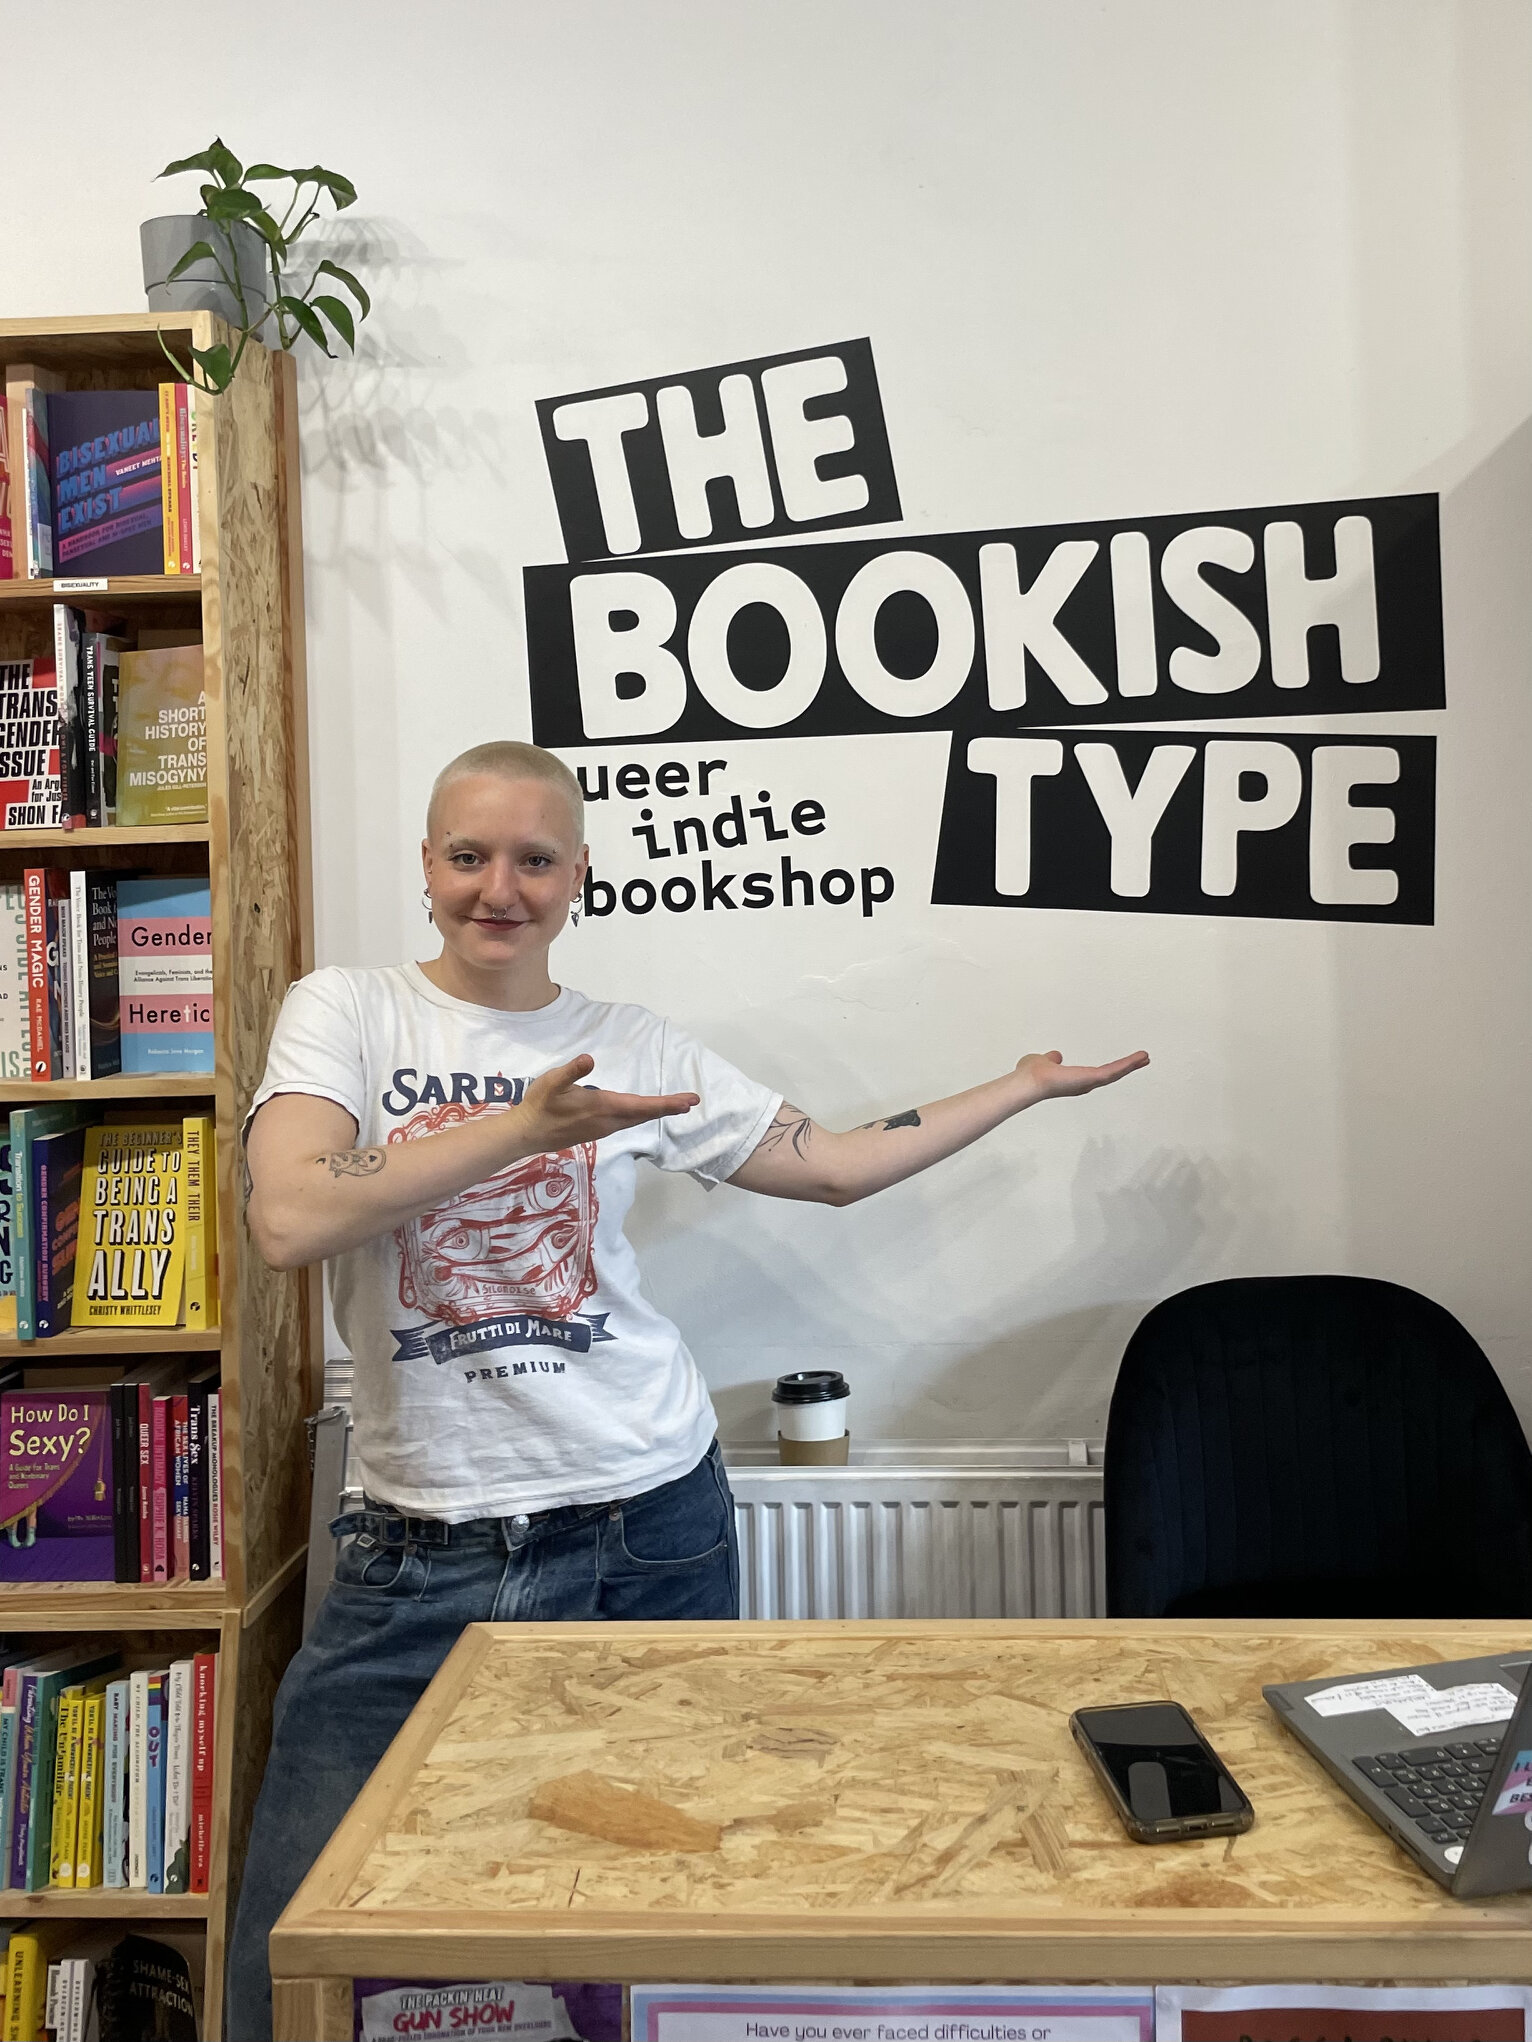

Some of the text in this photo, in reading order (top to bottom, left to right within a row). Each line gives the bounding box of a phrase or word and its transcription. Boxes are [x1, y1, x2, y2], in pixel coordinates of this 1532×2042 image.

[57, 417, 161, 477] BISEXUAL
[179, 407, 188, 459] Bisexuality:
[116, 462, 141, 476] VANEET
[552, 355, 869, 556] THE
[57, 464, 107, 506] MEN
[58, 486, 123, 535] EXIST
[61, 581, 99, 589] BISEXUALITY
[570, 515, 1381, 740] BOOKISH
[86, 645, 94, 669] TRANS
[0, 664, 31, 691] THE
[0, 690, 57, 719] TRANS
[87, 691, 96, 727] SURVIVAL
[198, 691, 205, 704] A
[158, 706, 206, 723] SHORT
[88, 729, 96, 752] GUIDE
[145, 722, 207, 740] HISTORY
[188, 737, 207, 751] OF
[0, 750, 46, 777] SSUE
[158, 752, 207, 769] TRANS
[32, 779, 42, 790] An
[129, 767, 207, 787] MISOGYNY
[577, 759, 728, 802] ueer
[31, 791, 43, 802] for
[8, 805, 45, 826] SHON
[631, 790, 827, 860] indie
[967, 740, 1400, 905] TYPE
[92, 886, 106, 900] The
[584, 856, 895, 918] bookshop
[92, 902, 112, 916] Book
[93, 919, 107, 930] and
[28, 875, 44, 988] GENDER MAGIC
[93, 933, 116, 948] People
[131, 924, 213, 947] Gender
[155, 975, 174, 983] Against
[176, 974, 189, 982] Trans
[129, 1003, 210, 1023] Heretic
[382, 1068, 527, 1117] SARDI
[99, 1130, 184, 1148] THE BEGINNER'S
[14, 1151, 23, 1192] Transition
[97, 1147, 182, 1175] GUIDE TO
[187, 1130, 200, 1221] THEY THEM THEIR
[94, 1175, 178, 1206] BEING A
[41, 1200, 49, 1261] CONFIRMATION
[92, 1208, 176, 1246] TRANS
[86, 1248, 172, 1301] ALLY
[89, 1304, 162, 1316] CHRISTY WHITTLESEY
[449, 1319, 573, 1351] FRUTTI DI MARE
[464, 1361, 567, 1384] PREMIUM
[11, 1403, 90, 1424] How Do I
[8, 1426, 92, 1462] Sexy?
[140, 1423, 149, 1465] QUEER SEX
[154, 1407, 166, 1484] RADICAL INTIMACY
[174, 1420, 182, 1453] AFRICAN
[190, 1405, 201, 1465] Trans Sex
[24, 1684, 37, 1724] Parenting
[60, 1706, 70, 1729] The
[196, 1665, 208, 1771] knocking myself up
[2, 1718, 9, 1731] MY
[148, 1726, 160, 1768] OUT
[56, 1731, 68, 1796] Unfamiliar
[197, 1814, 206, 1852] michelle
[10, 1951, 24, 2021] UNLEARNING
[129, 1981, 193, 2017] ATTRACTION
[400, 1994, 424, 2010] THE
[474, 1987, 505, 2003] HEAT
[393, 2000, 515, 2033] GUN SHOW
[746, 2022, 1051, 2042] Have you ever faced difficulties or
